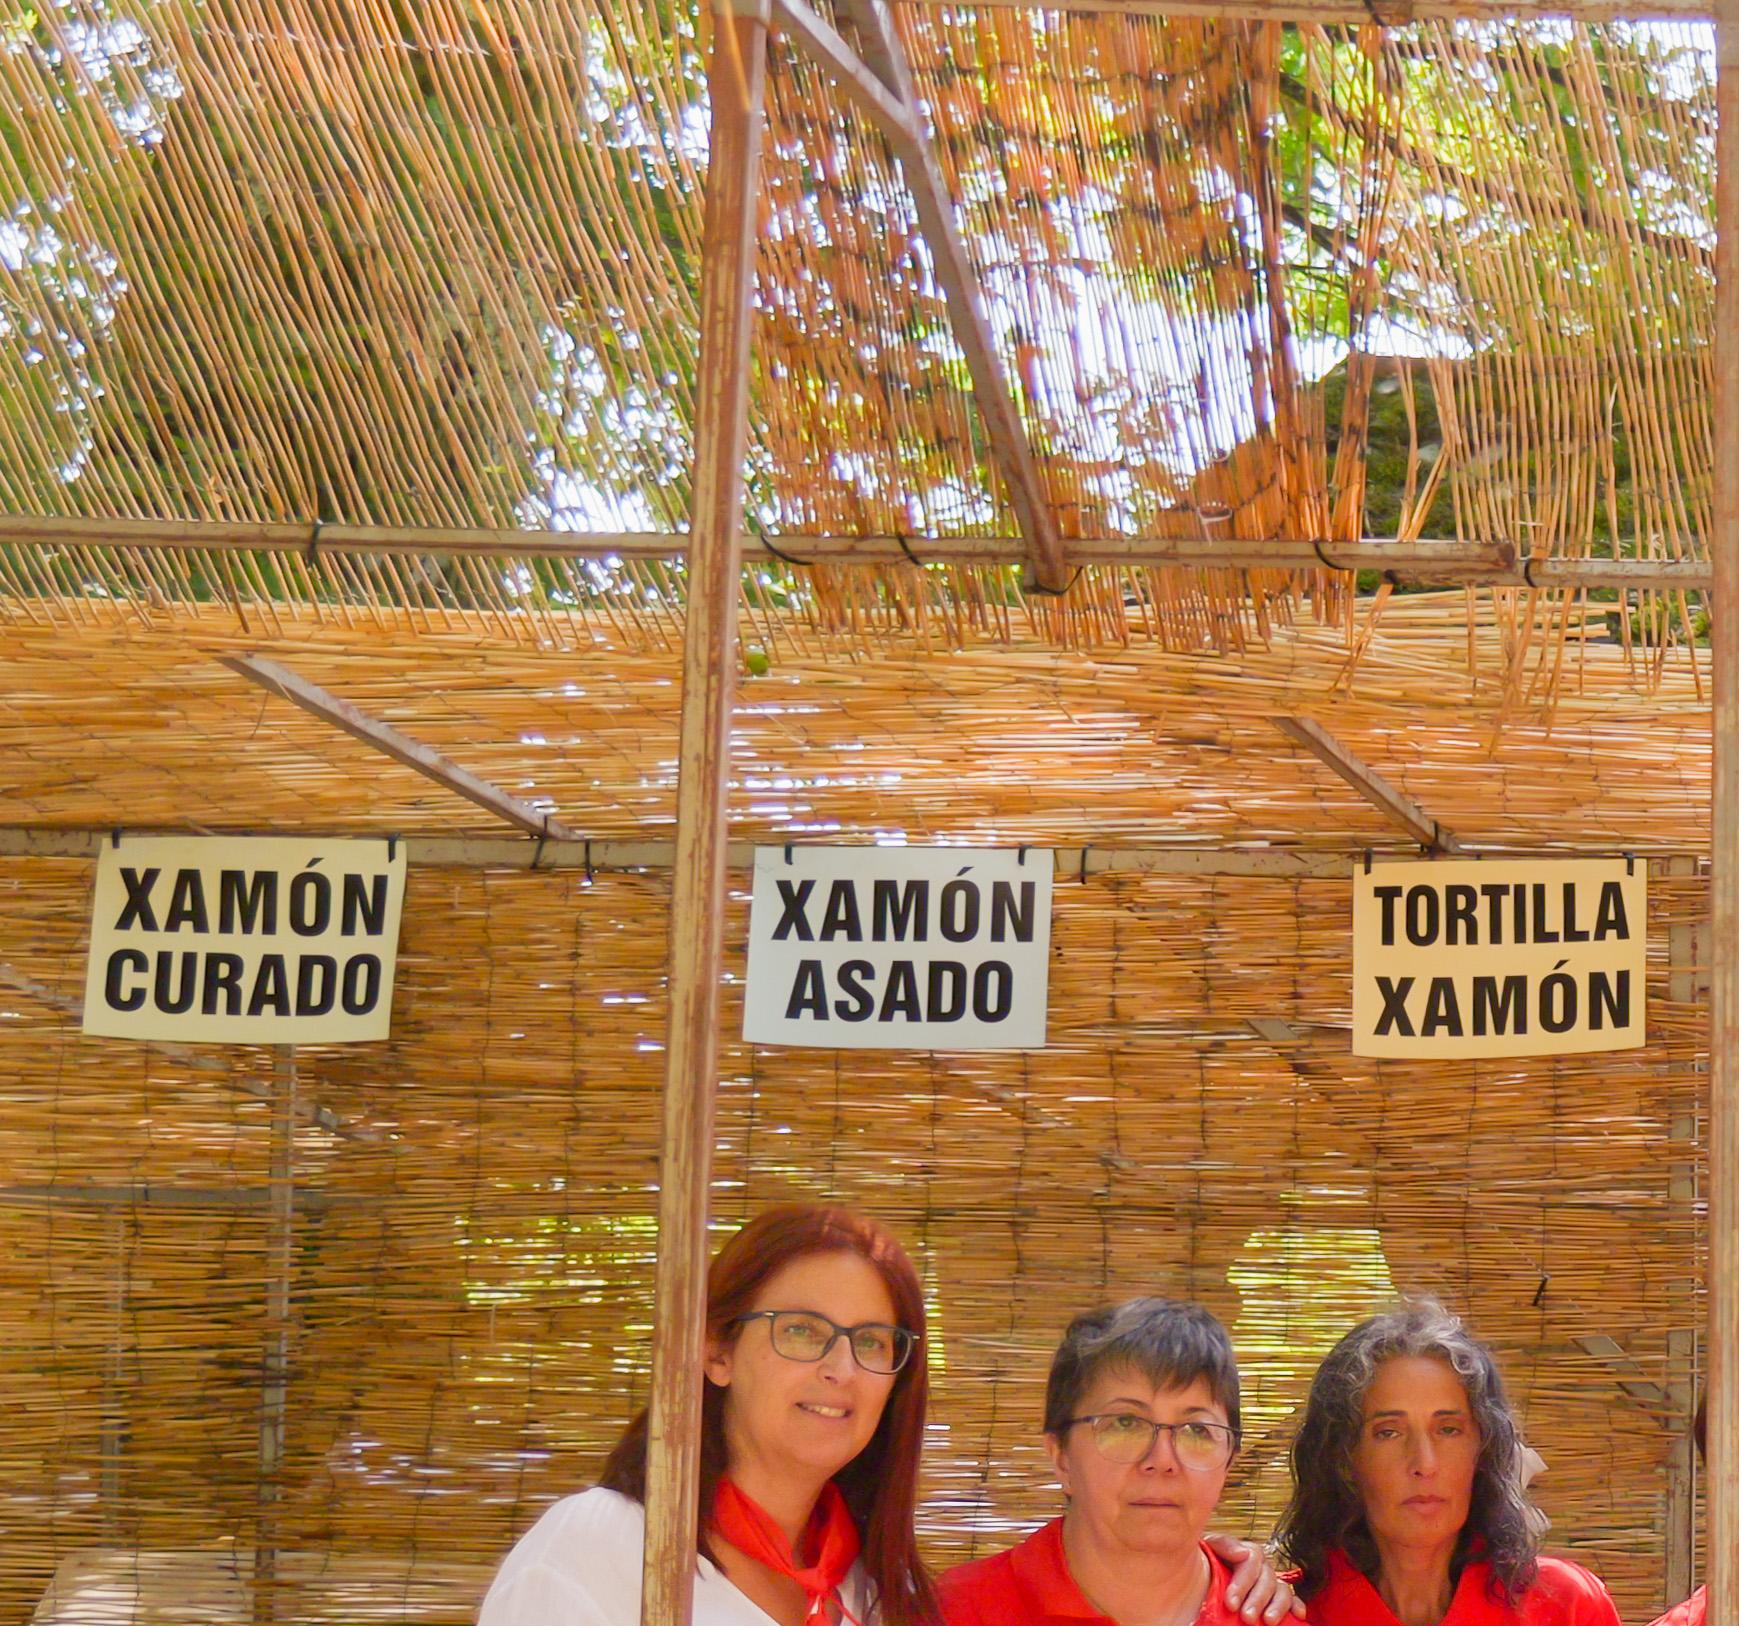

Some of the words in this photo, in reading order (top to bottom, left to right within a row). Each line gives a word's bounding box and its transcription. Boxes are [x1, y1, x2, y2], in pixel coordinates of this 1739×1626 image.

[114, 857, 388, 937] XAMÓN
[771, 866, 1036, 943] XAMÓN
[1373, 881, 1630, 947] TORTILLA
[105, 948, 382, 1017] CURADO
[785, 960, 1013, 1023] ASADO
[1373, 959, 1630, 1037] XAMÓN
